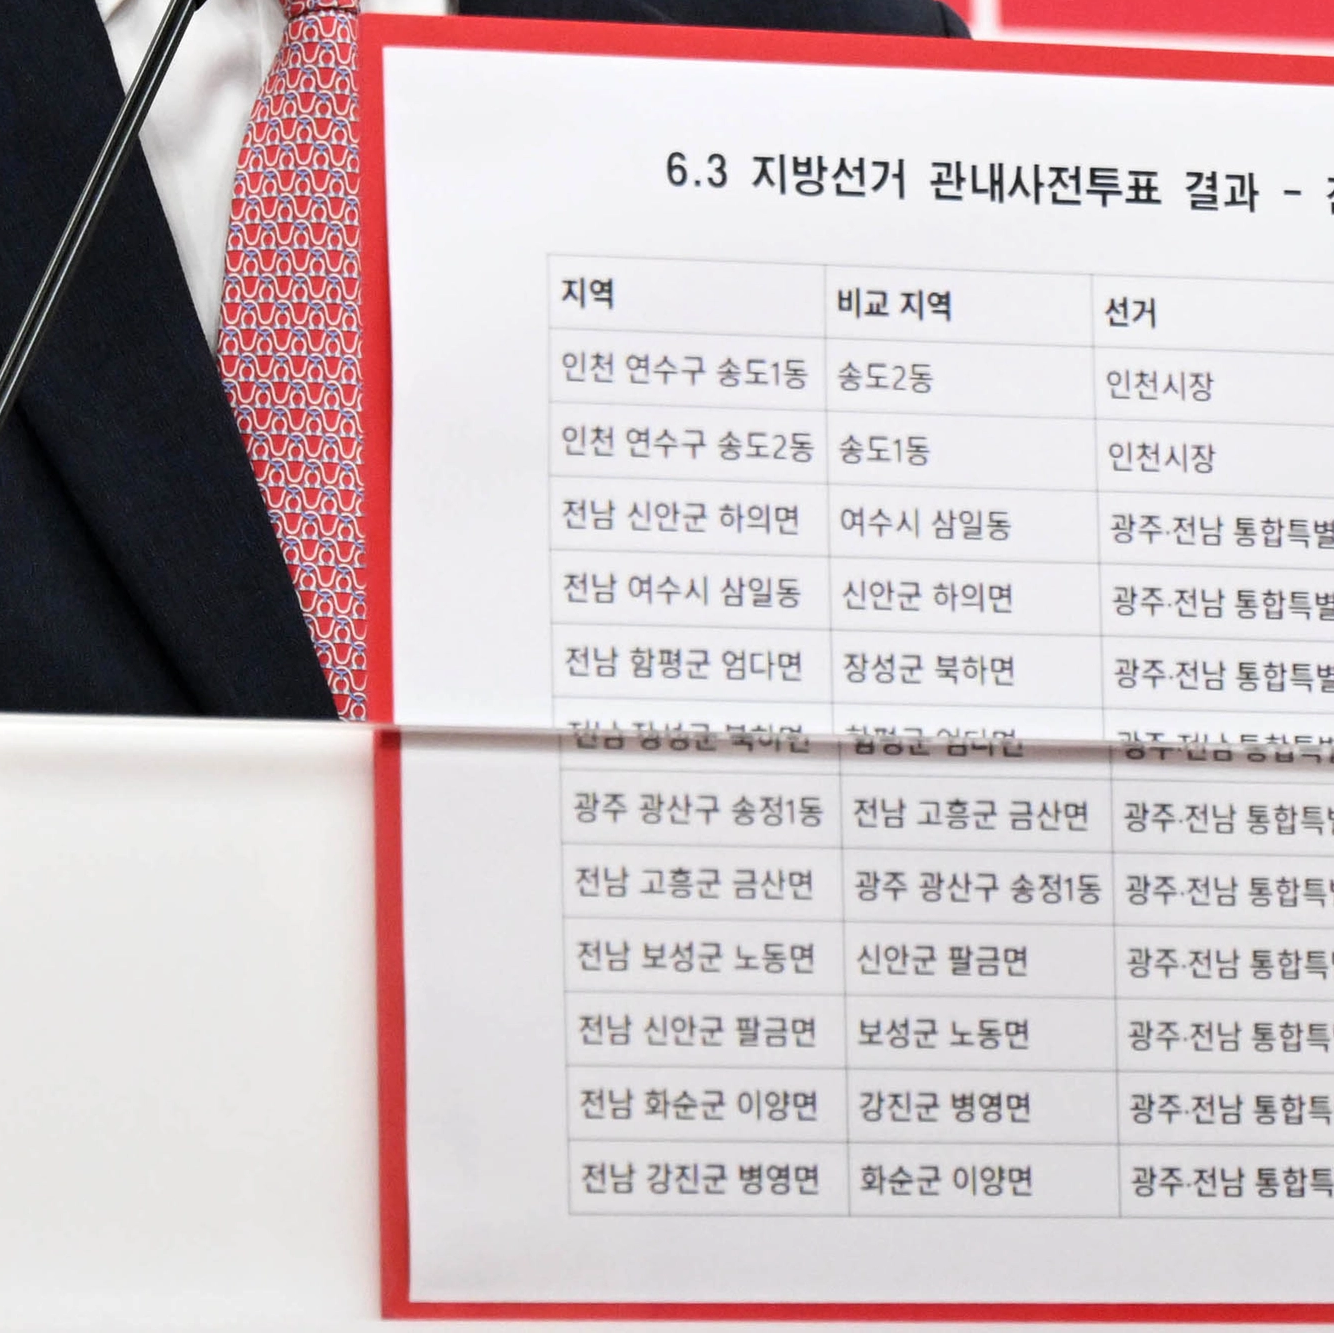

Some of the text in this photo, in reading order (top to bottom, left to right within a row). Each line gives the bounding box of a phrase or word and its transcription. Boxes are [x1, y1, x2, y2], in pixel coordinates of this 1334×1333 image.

[666, 151, 728, 189] 6.3
[751, 153, 905, 200] 지방선거
[929, 160, 1163, 208] 관내사전투표
[1185, 170, 1260, 214] 결과
[561, 276, 614, 310] 지역
[837, 287, 890, 319] 비교
[900, 289, 952, 322] 지역
[1104, 296, 1156, 329] 선거
[562, 352, 613, 383] 인천
[625, 354, 706, 385] 연수구
[717, 357, 808, 390] 송도1동
[838, 361, 933, 394] 송도2동
[1106, 369, 1214, 402] 인천시장
[562, 425, 614, 457] 인천
[626, 427, 706, 459] 연수구
[718, 430, 814, 463] 송도2동
[839, 434, 930, 466] 송도1동
[1108, 441, 1216, 474] 인천시장
[563, 499, 616, 530] 전남
[628, 501, 707, 533] 신안군
[719, 504, 798, 535] 하의면
[840, 507, 919, 537] 여수시
[932, 509, 1011, 541] 삼일동
[564, 573, 617, 604] 전남
[628, 575, 708, 605] 여수시
[721, 577, 801, 609] 삼일동
[843, 580, 921, 612] 신안군
[933, 582, 1012, 614] 하의면
[566, 646, 619, 678] 전남
[631, 647, 710, 680] 함평군
[722, 650, 801, 682] 엄다면
[845, 653, 923, 685] 장성군
[935, 655, 1014, 687] 북하면
[574, 792, 627, 823] 광주
[639, 793, 720, 825] 광산구
[732, 795, 823, 828] 송정1동
[854, 797, 906, 829] 전남
[917, 798, 998, 830] 고흥군
[1009, 800, 1088, 832] 금산면
[576, 867, 629, 898] 전남
[641, 867, 721, 899] 고흥군
[733, 869, 812, 900] 금산면
[855, 871, 907, 902] 광주
[919, 871, 999, 903] 광산구
[1010, 873, 1101, 905] 송정1동
[578, 941, 630, 972] 전남
[643, 942, 722, 973] 보성군
[735, 943, 814, 974] 노동면
[857, 944, 937, 976] 신안군
[948, 945, 1027, 977] 팔금면
[579, 1014, 632, 1046] 전남
[644, 1016, 724, 1047] 신안군
[736, 1016, 815, 1048] 팔금면
[859, 1018, 938, 1049] 보성군
[950, 1019, 1029, 1050] 노동면
[581, 1088, 633, 1120] 전남
[645, 1089, 725, 1121] 화순군
[737, 1090, 817, 1122] 이양면
[860, 1091, 940, 1123] 강진군
[951, 1092, 1030, 1123] 병영면
[582, 1163, 635, 1194] 전남
[647, 1163, 727, 1195] 강진군
[739, 1164, 818, 1196] 병영면
[861, 1164, 942, 1196] 화순군
[953, 1165, 1032, 1197] 이양면
